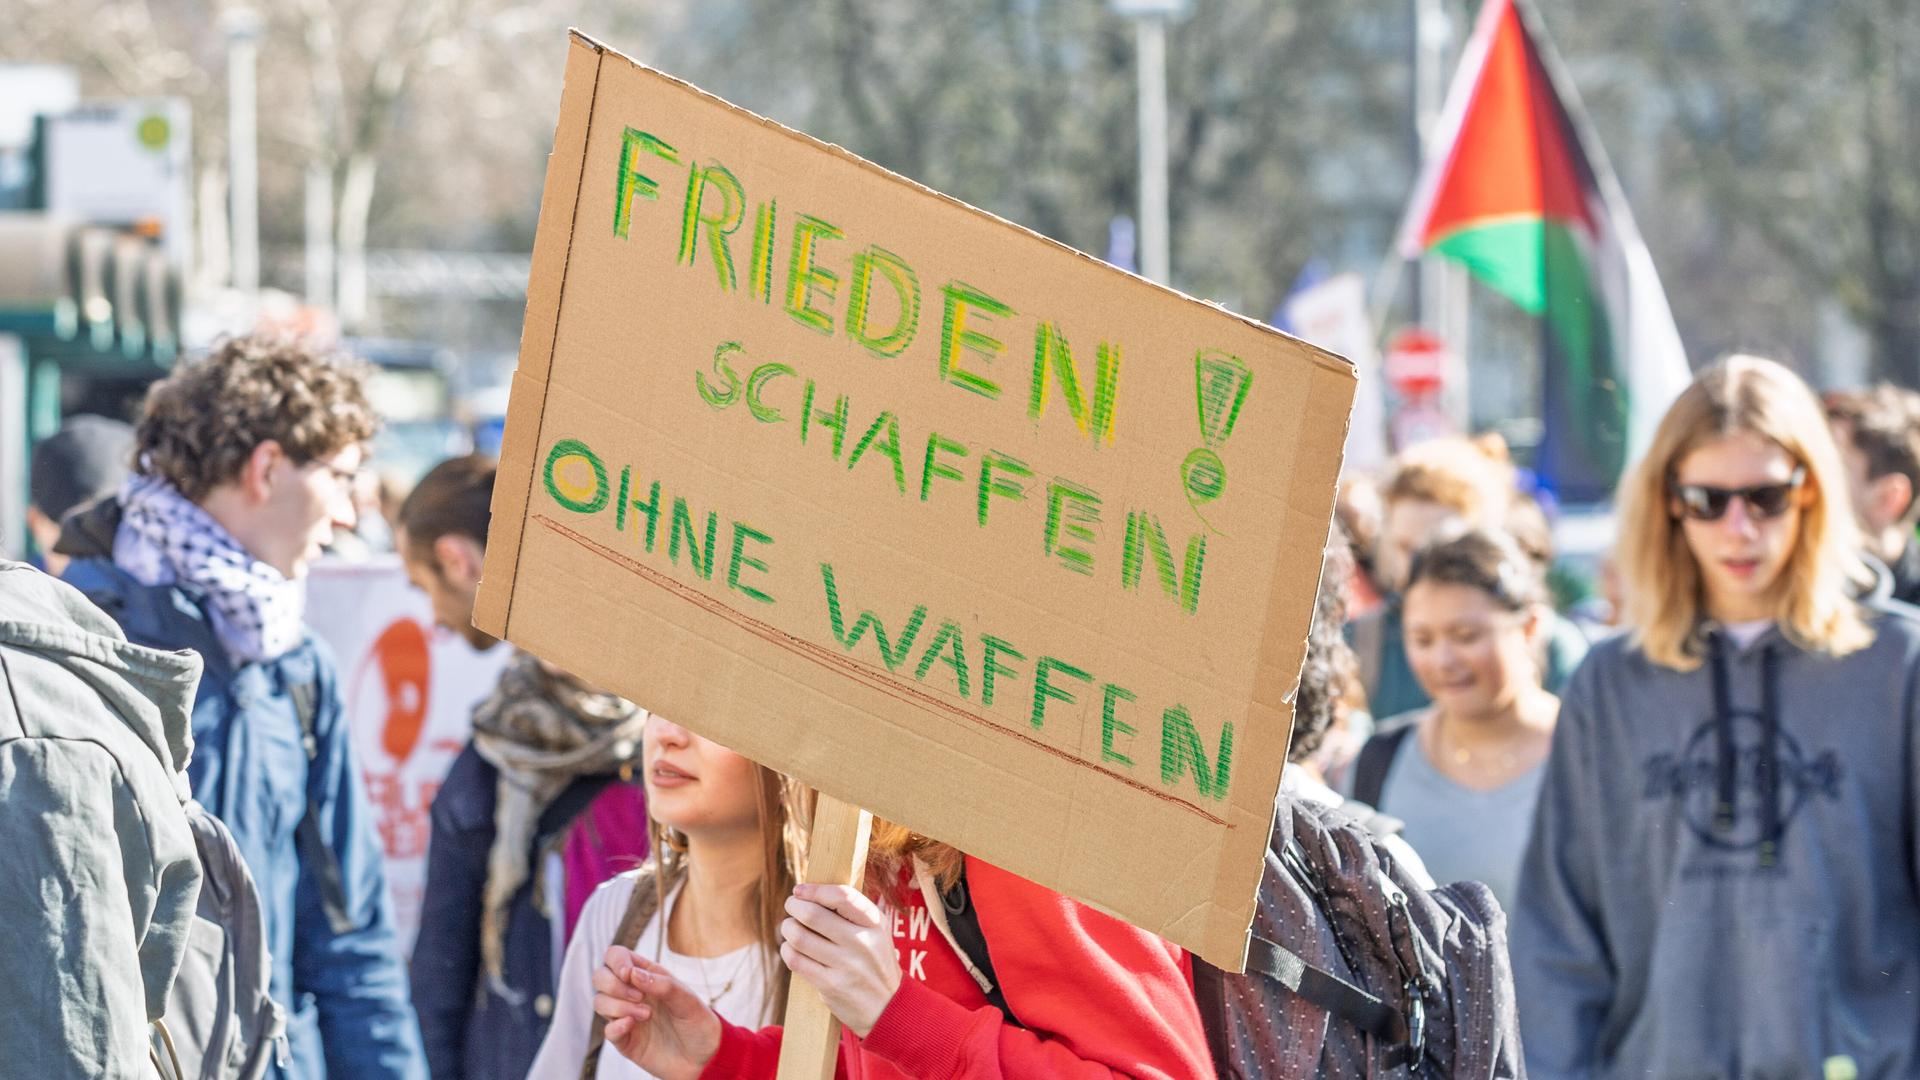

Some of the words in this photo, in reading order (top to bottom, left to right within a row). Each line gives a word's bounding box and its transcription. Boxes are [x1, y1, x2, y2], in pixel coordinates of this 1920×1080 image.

[613, 127, 1120, 449] FRIEDEN
[543, 438, 776, 603] OHNE
[820, 562, 1233, 801] WAFFEN
[696, 341, 1206, 615] SCHAFFEN
